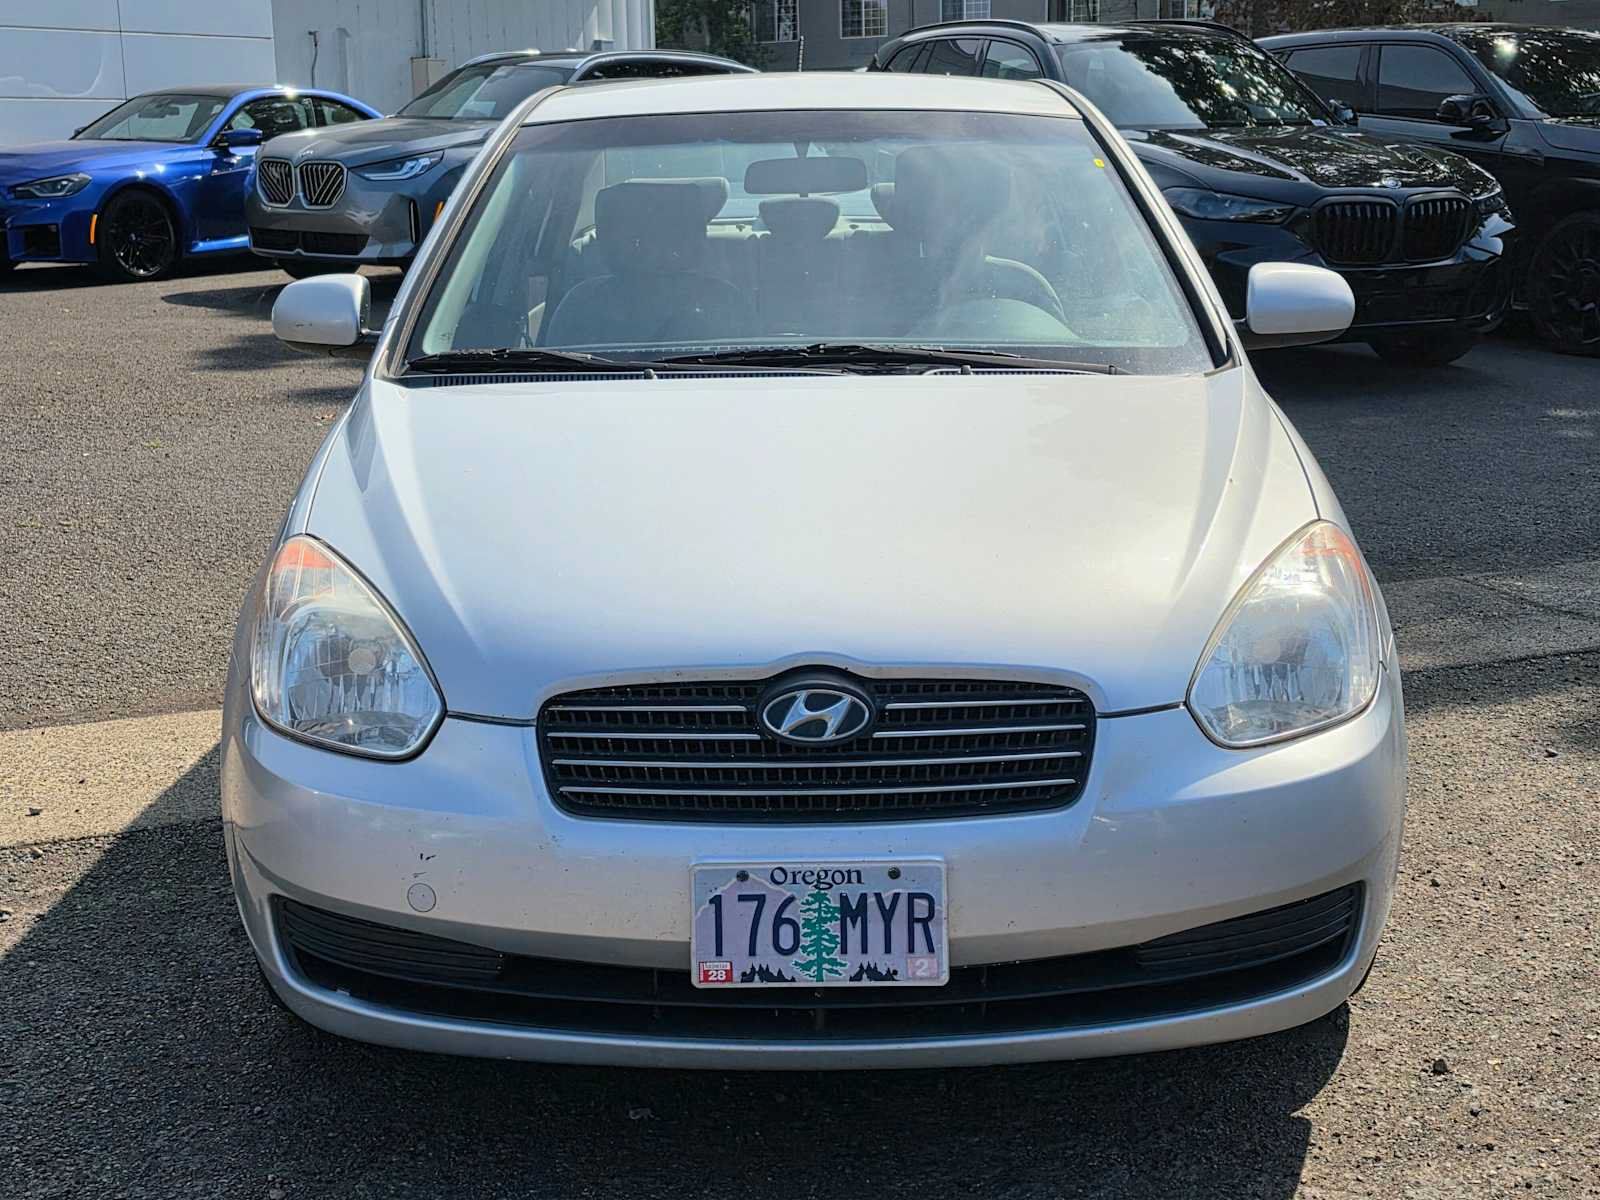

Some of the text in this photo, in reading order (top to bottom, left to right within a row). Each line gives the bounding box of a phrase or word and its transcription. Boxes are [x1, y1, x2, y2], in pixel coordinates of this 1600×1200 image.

[770, 866, 864, 890] Oregon
[708, 892, 936, 957] 176 MYR
[708, 970, 727, 981] 28
[915, 959, 929, 976] 2
